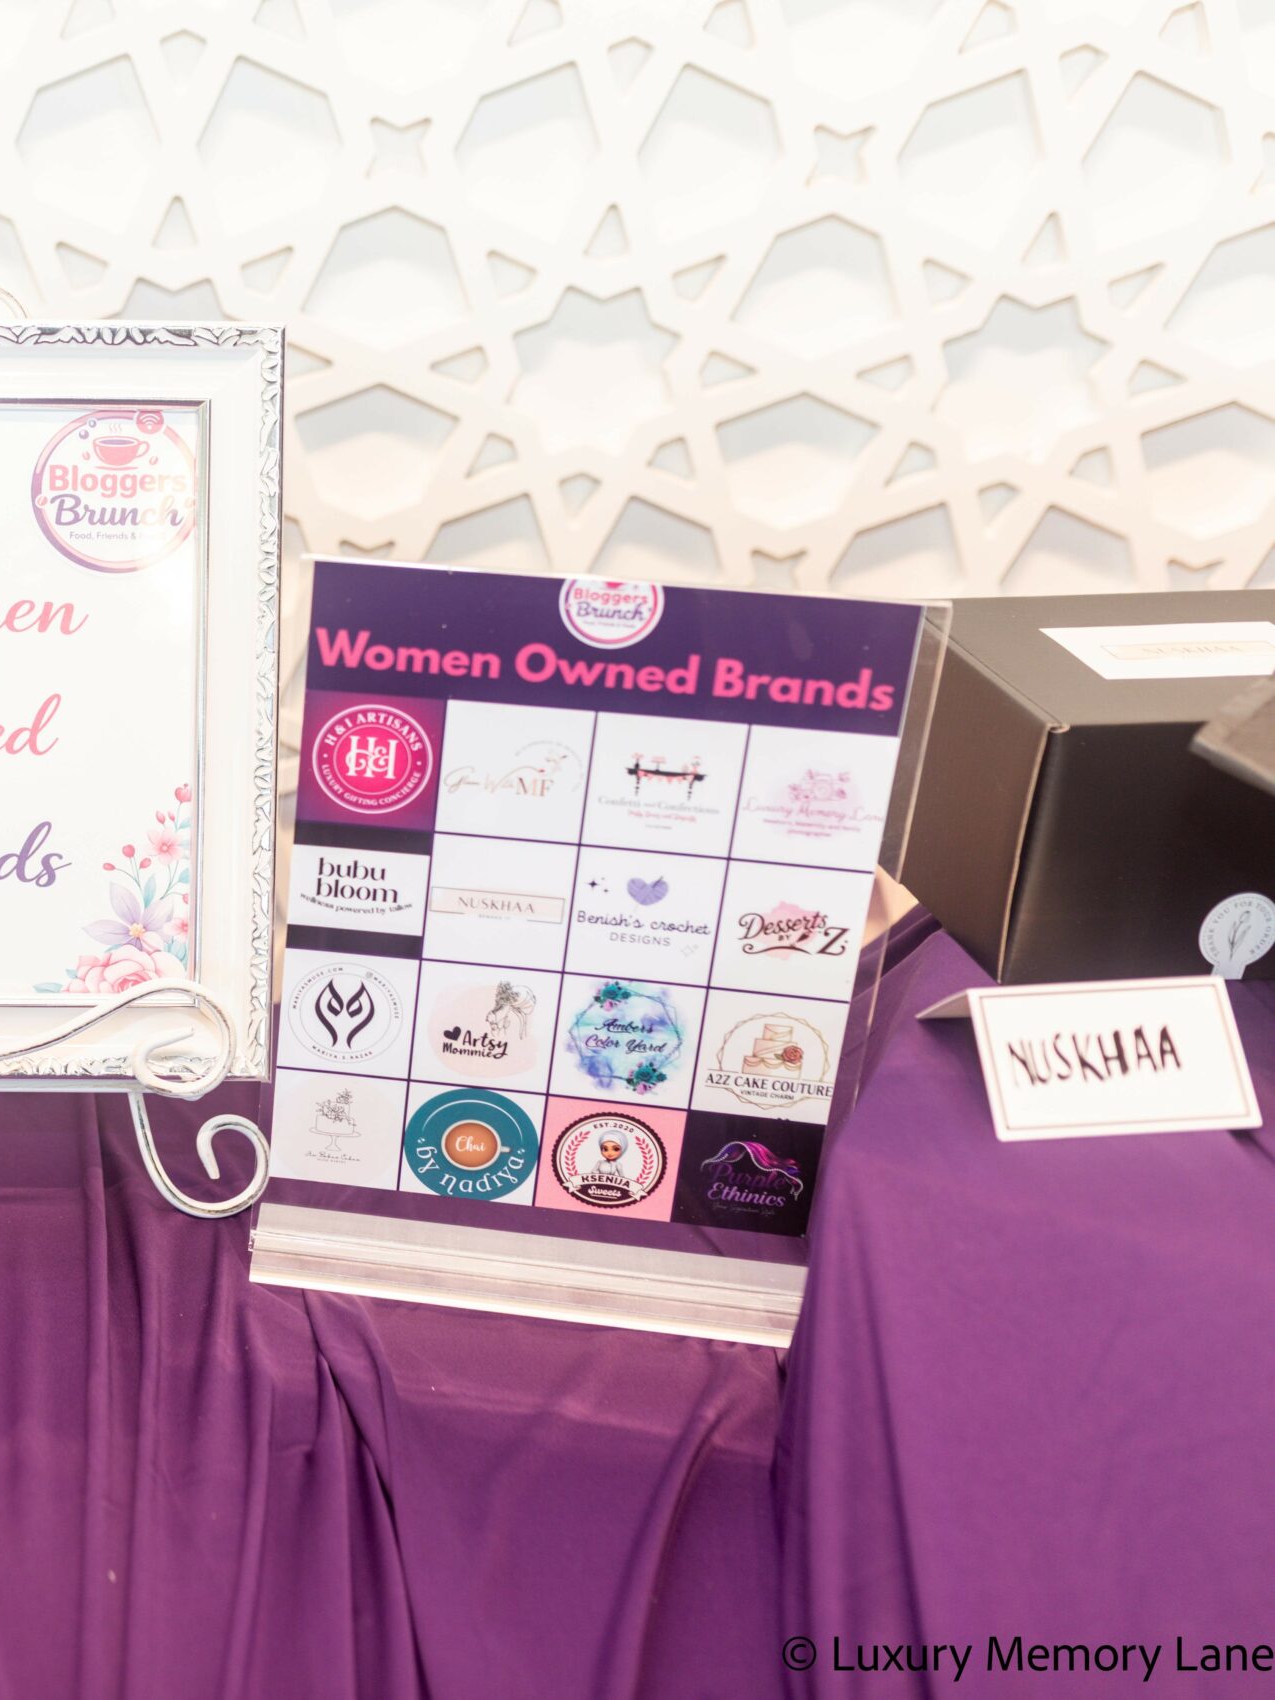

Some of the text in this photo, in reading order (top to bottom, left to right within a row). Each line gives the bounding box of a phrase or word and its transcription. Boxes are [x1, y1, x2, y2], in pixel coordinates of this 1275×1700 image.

[48, 464, 187, 500] Bloggers
[49, 493, 186, 528] Brunch
[69, 531, 94, 541] Food,
[96, 531, 129, 540] Friends
[574, 588, 647, 606] Bloggers
[576, 601, 645, 621] Brunch
[315, 627, 895, 712] Women Owned Brands
[324, 733, 337, 747] H
[334, 723, 347, 735] &
[356, 711, 423, 752] ARTISANS
[321, 763, 422, 806] LUXURY GIFTING CONCIERGE
[318, 857, 386, 881] bubu
[315, 877, 398, 904] bloom
[335, 903, 375, 915] powered
[458, 896, 535, 914] NUSKHAA
[1212, 907, 1231, 924] YOU
[1233, 901, 1253, 909] FOR
[576, 909, 711, 935] Benish's crochet
[738, 911, 829, 940] Desserts
[609, 931, 671, 947] DESIGNS
[816, 926, 850, 956] Z
[462, 1029, 508, 1059] Artsy
[585, 1034, 667, 1054] Color Yard
[1007, 1025, 1182, 1088] NUSKHAA
[705, 1073, 834, 1098] A2Z CAKE COUTURE
[740, 1088, 795, 1101] VINTAGE CHARM
[455, 1135, 486, 1152] Chai
[581, 1173, 631, 1188] KSENIJA
[709, 1162, 786, 1190] Purple
[587, 1185, 622, 1198] Sweets
[707, 1182, 786, 1208] Ethinics
